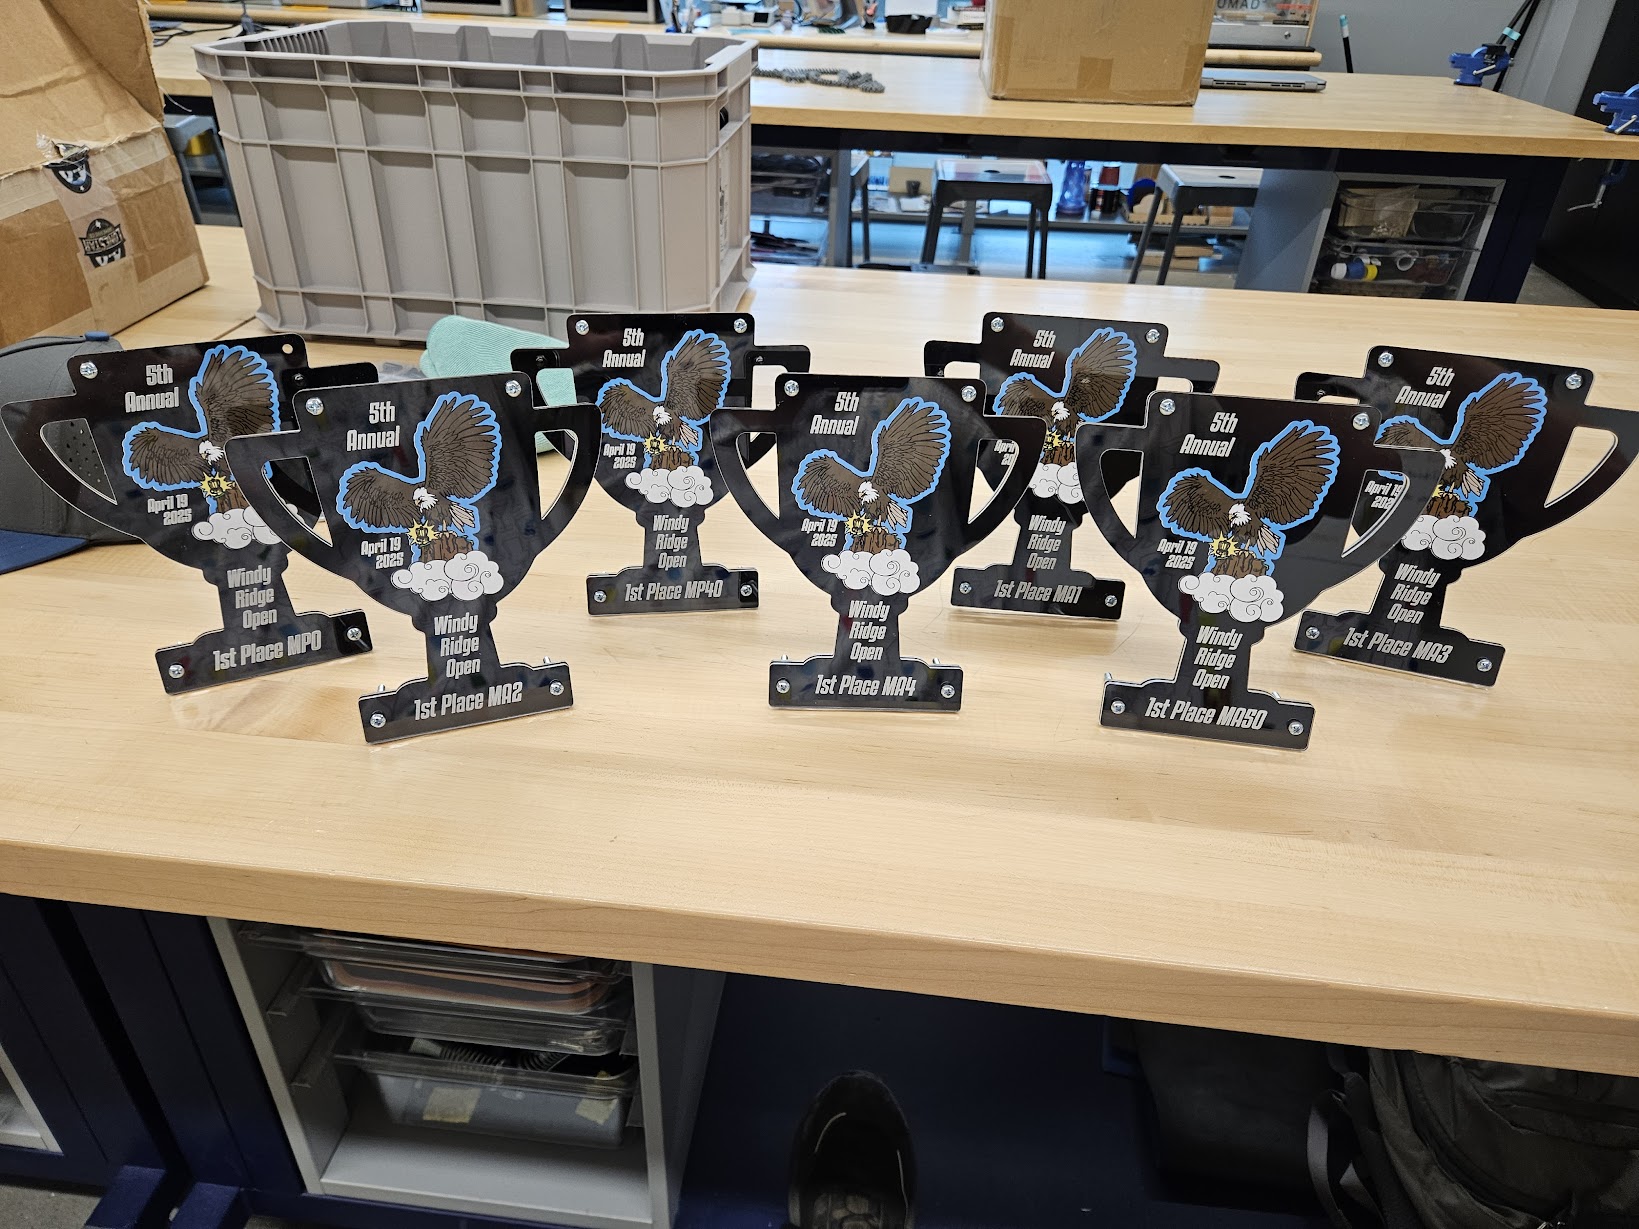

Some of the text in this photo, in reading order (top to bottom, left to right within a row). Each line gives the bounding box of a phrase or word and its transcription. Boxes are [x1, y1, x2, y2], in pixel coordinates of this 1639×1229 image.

[623, 328, 644, 346] 5th
[1033, 330, 1056, 348] 5th
[602, 349, 646, 367] Annual
[1010, 349, 1055, 368] Annual
[146, 364, 173, 385] 5th
[1426, 367, 1455, 386] 5th
[125, 387, 179, 412] Annual
[835, 392, 859, 412] 5th
[1395, 386, 1450, 408] Annual
[369, 401, 395, 424] 5th
[1210, 412, 1238, 433] 5th
[810, 415, 860, 435] Annual
[347, 426, 400, 451] Annual
[994, 440, 1016, 453] Apri
[1180, 434, 1236, 457] Annual
[603, 443, 636, 457] April 19
[613, 456, 636, 469] 2025
[1365, 481, 1392, 495] April
[148, 494, 188, 514] April 19
[1371, 496, 1395, 509] 202
[163, 508, 192, 525] 2025
[653, 514, 689, 533] Windy
[801, 518, 837, 534] April 19
[1028, 515, 1066, 535] Windy
[361, 537, 401, 557] April 19
[656, 534, 688, 552] Ridge
[811, 533, 838, 546] 2025
[1027, 534, 1061, 553] Ridge
[1157, 539, 1198, 554] April 19
[376, 552, 404, 569] 2025
[658, 552, 687, 570] Open
[1027, 553, 1057, 571] Open
[1165, 554, 1195, 569] 2025
[227, 565, 271, 588] Windy
[1394, 563, 1441, 588] Windy
[236, 588, 274, 608] Ridge
[625, 580, 723, 601] 1st Place MP40
[994, 580, 1082, 603] 1st Place MA1
[1390, 584, 1432, 606] Ridge
[243, 609, 277, 630] Open
[848, 600, 890, 622] Windy
[1387, 604, 1424, 624] Open
[434, 612, 478, 635] Windy
[849, 622, 886, 642] Ridge
[440, 635, 479, 656] Ridge
[1196, 626, 1243, 650] Windy
[1343, 627, 1453, 663] 1st Place MA3
[213, 648, 236, 671] 1st
[241, 642, 283, 665] Place
[850, 642, 883, 662] Open
[1194, 648, 1236, 670] Ridge
[446, 659, 480, 679] Open
[1192, 669, 1230, 689] Open
[815, 674, 916, 696] 1st Place MA4
[414, 682, 522, 720] 1st Place MA2
[1145, 697, 1268, 730] 1st Place MA50
